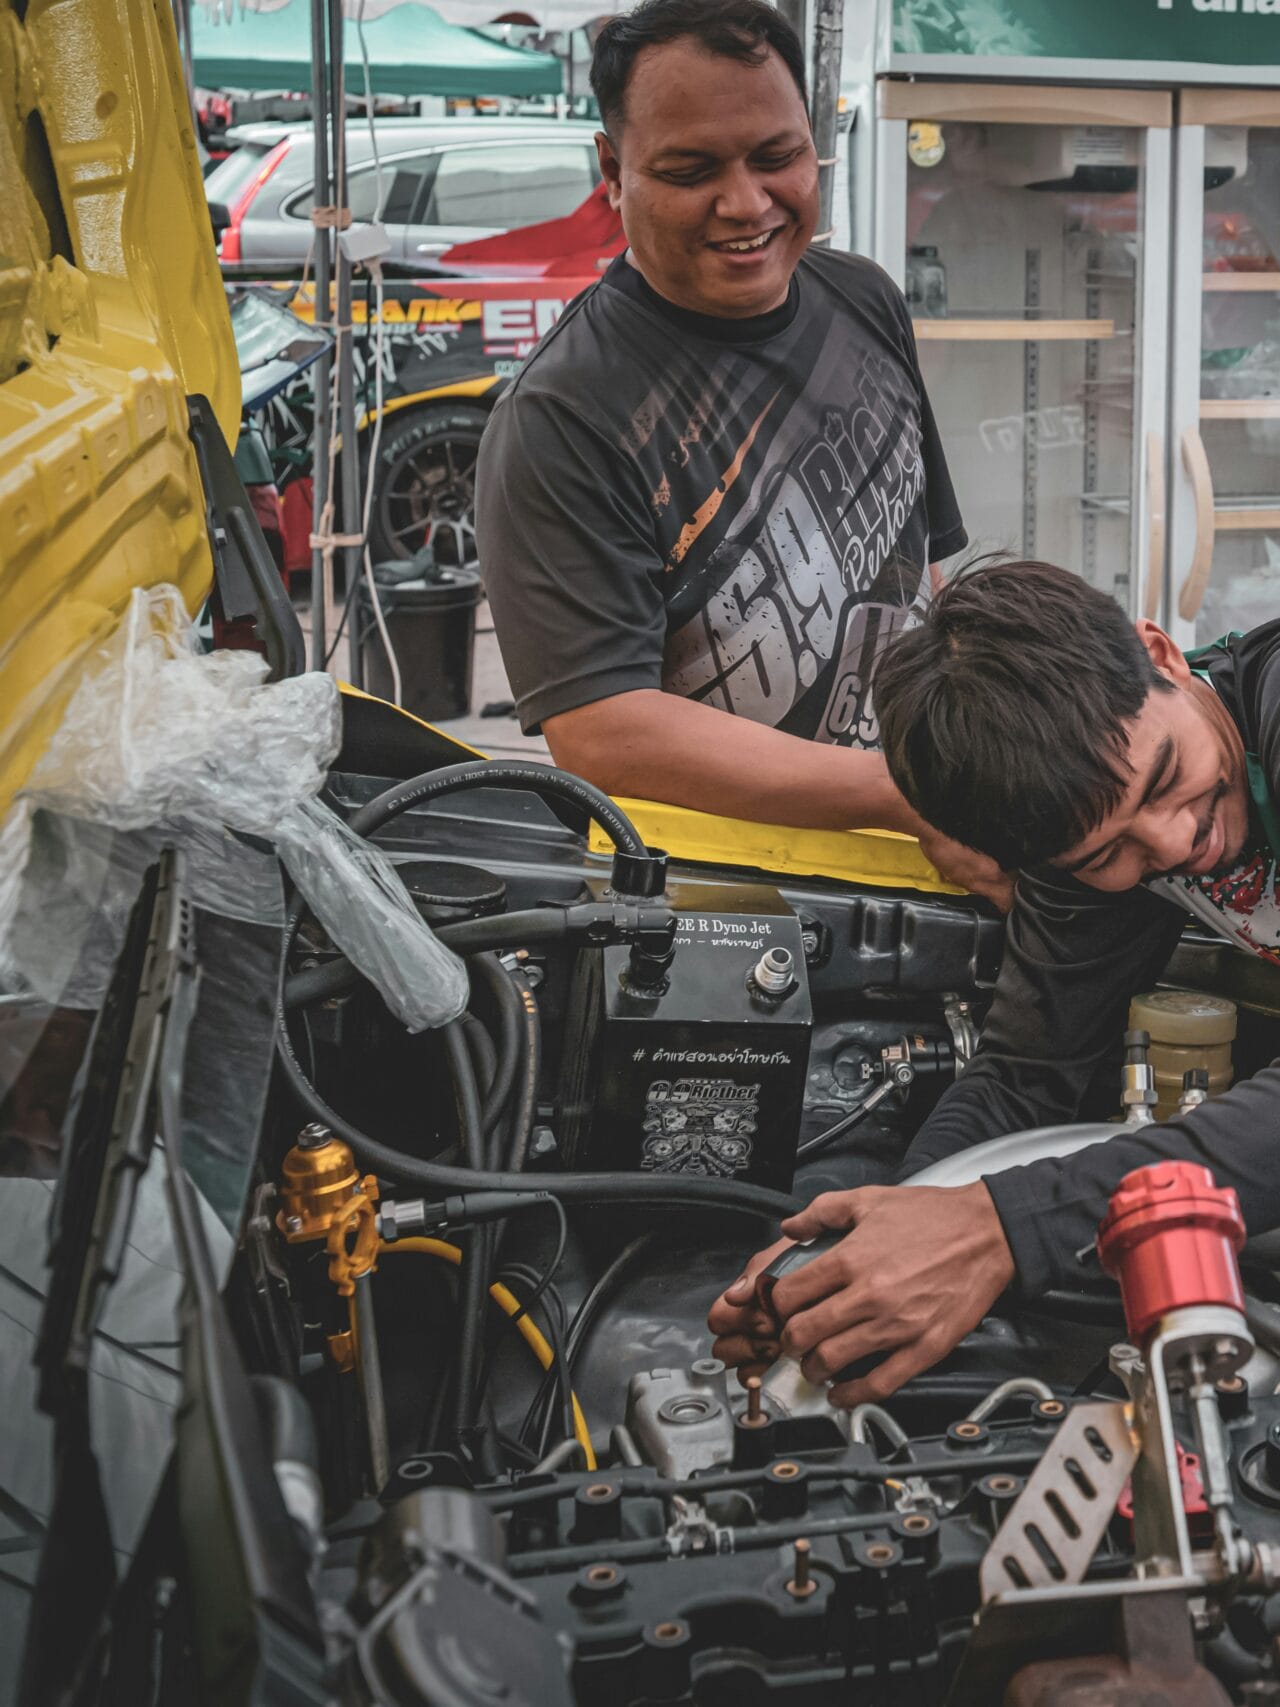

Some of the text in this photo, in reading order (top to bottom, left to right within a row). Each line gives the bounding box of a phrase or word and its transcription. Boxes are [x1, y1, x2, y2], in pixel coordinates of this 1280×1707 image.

[698, 919, 709, 932] R
[713, 920, 747, 935] Dyno
[750, 921, 772, 934] Jet
